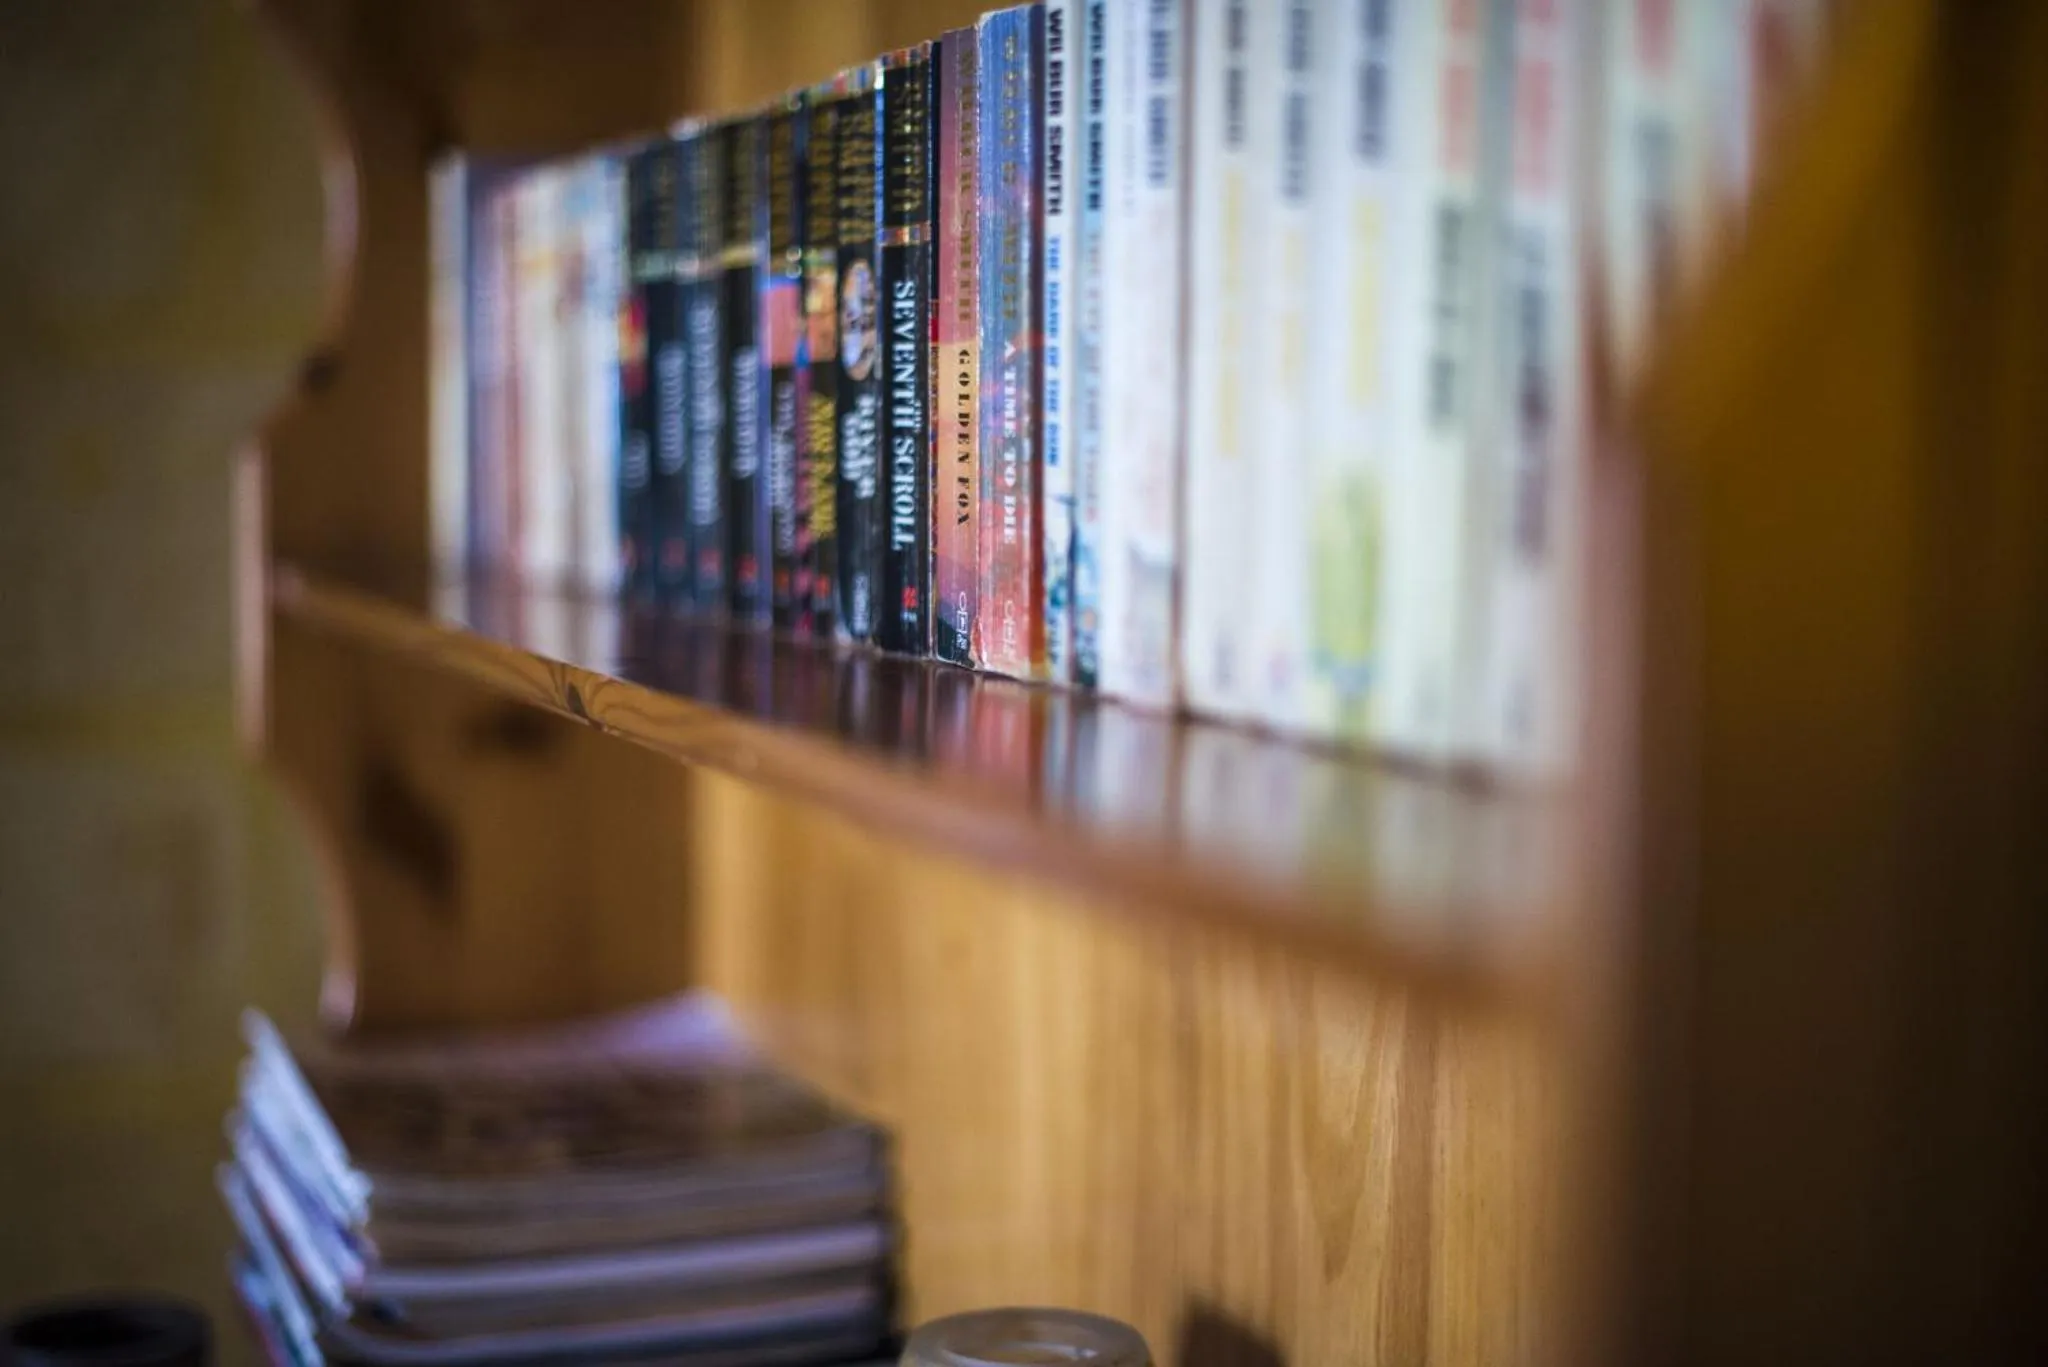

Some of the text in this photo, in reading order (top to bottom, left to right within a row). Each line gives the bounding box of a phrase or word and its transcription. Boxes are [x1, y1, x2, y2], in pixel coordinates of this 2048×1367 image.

[1047, 8, 1065, 216] WILBUR SMITH
[891, 281, 916, 551] SEVENTH SCROLL
[957, 348, 971, 527] GOLDEN FOX
[1003, 340, 1017, 545] A TIME TO DIE
